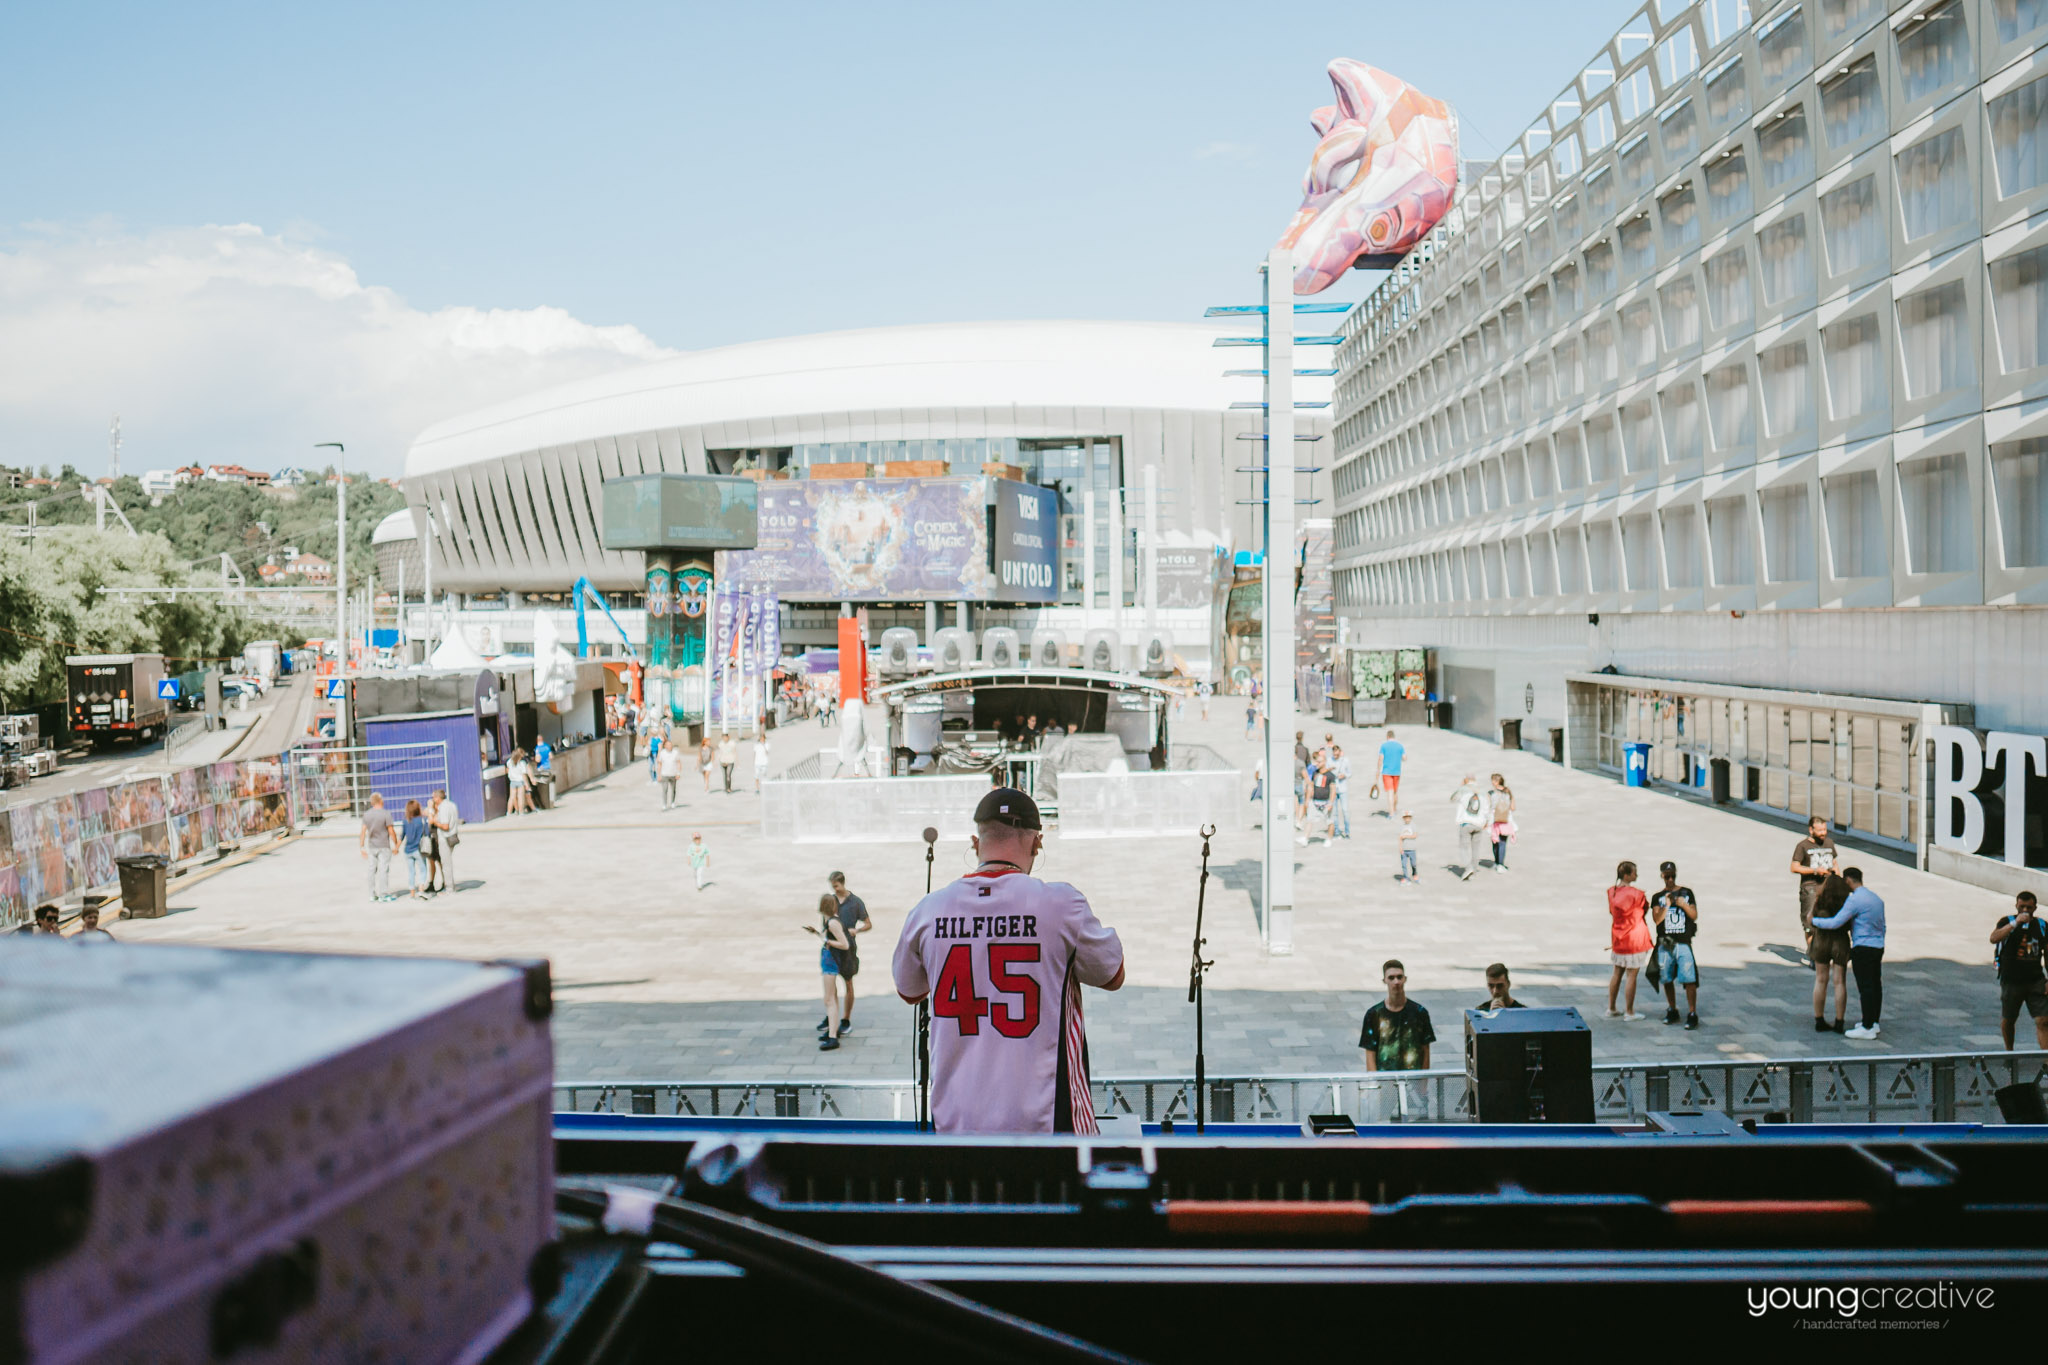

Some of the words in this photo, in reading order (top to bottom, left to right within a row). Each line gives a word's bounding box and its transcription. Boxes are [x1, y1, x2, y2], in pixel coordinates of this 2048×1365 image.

[1017, 493, 1039, 520] VISA
[760, 515, 797, 528] TOLD
[914, 520, 958, 537] CODEX
[1003, 560, 1052, 588] UNTOLD
[764, 600, 775, 667] UNTOLD
[935, 915, 1037, 938] HILFIGER
[933, 943, 1041, 1038] 45
